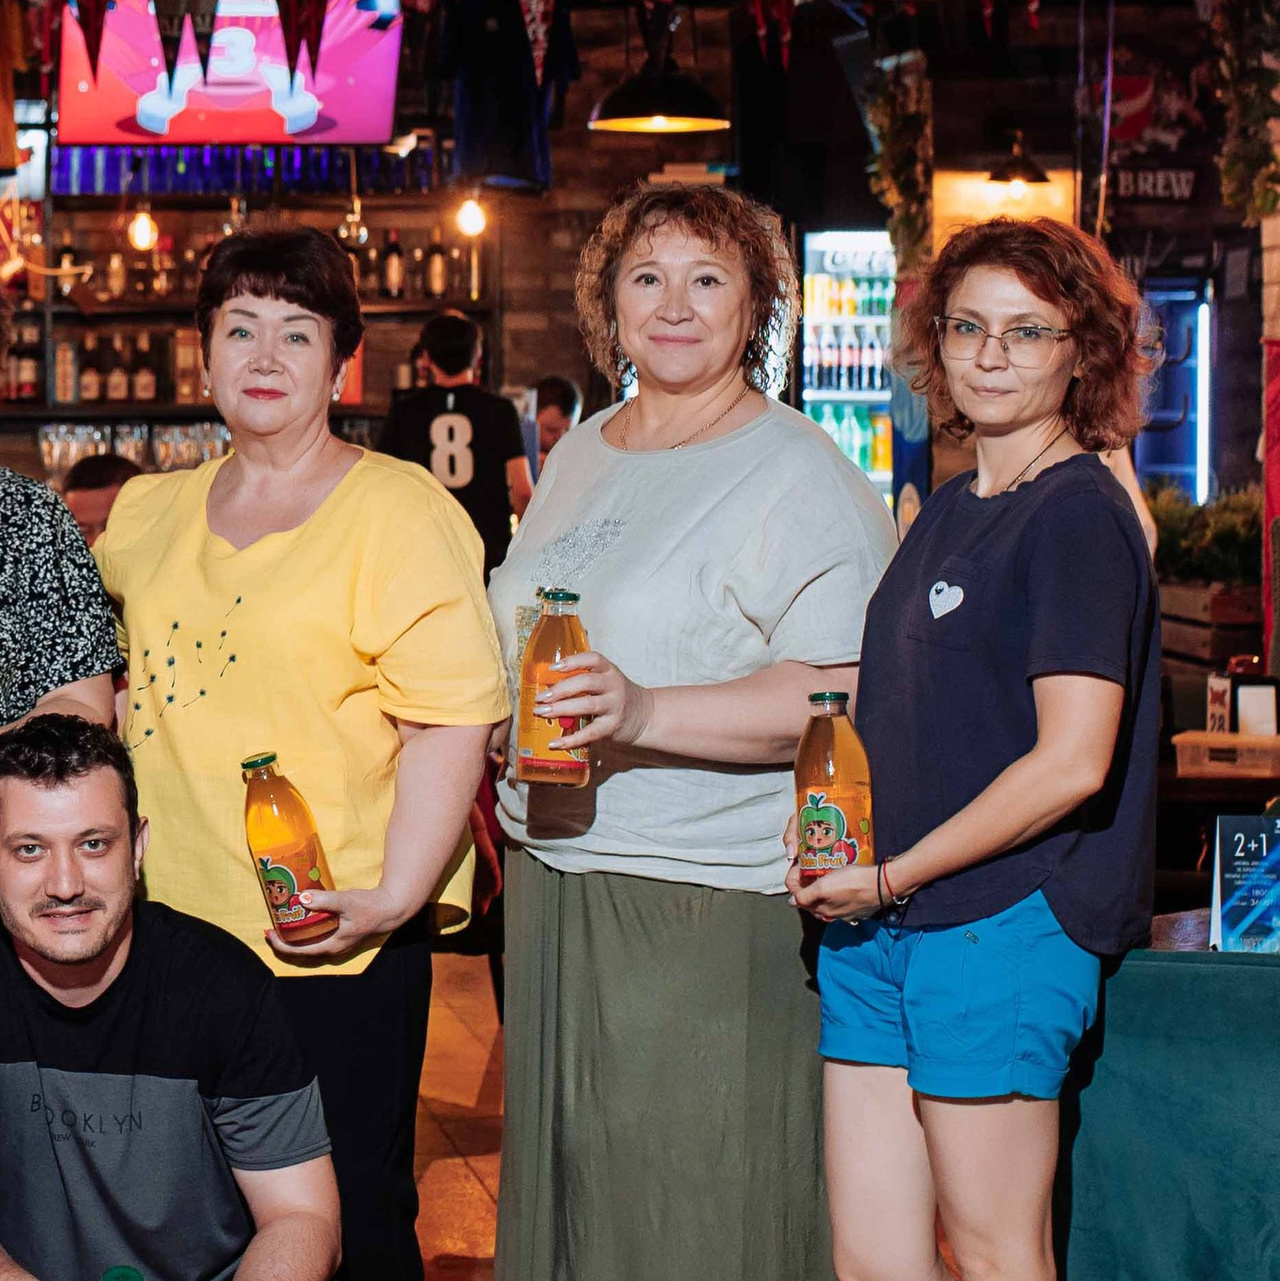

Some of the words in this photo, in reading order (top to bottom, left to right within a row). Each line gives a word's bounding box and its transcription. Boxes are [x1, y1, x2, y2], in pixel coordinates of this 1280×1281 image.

[211, 26, 256, 77] 3
[1117, 168, 1196, 201] BREW
[429, 412, 476, 489] 8
[818, 853, 845, 867] Fruit
[1234, 832, 1268, 858] 2+1
